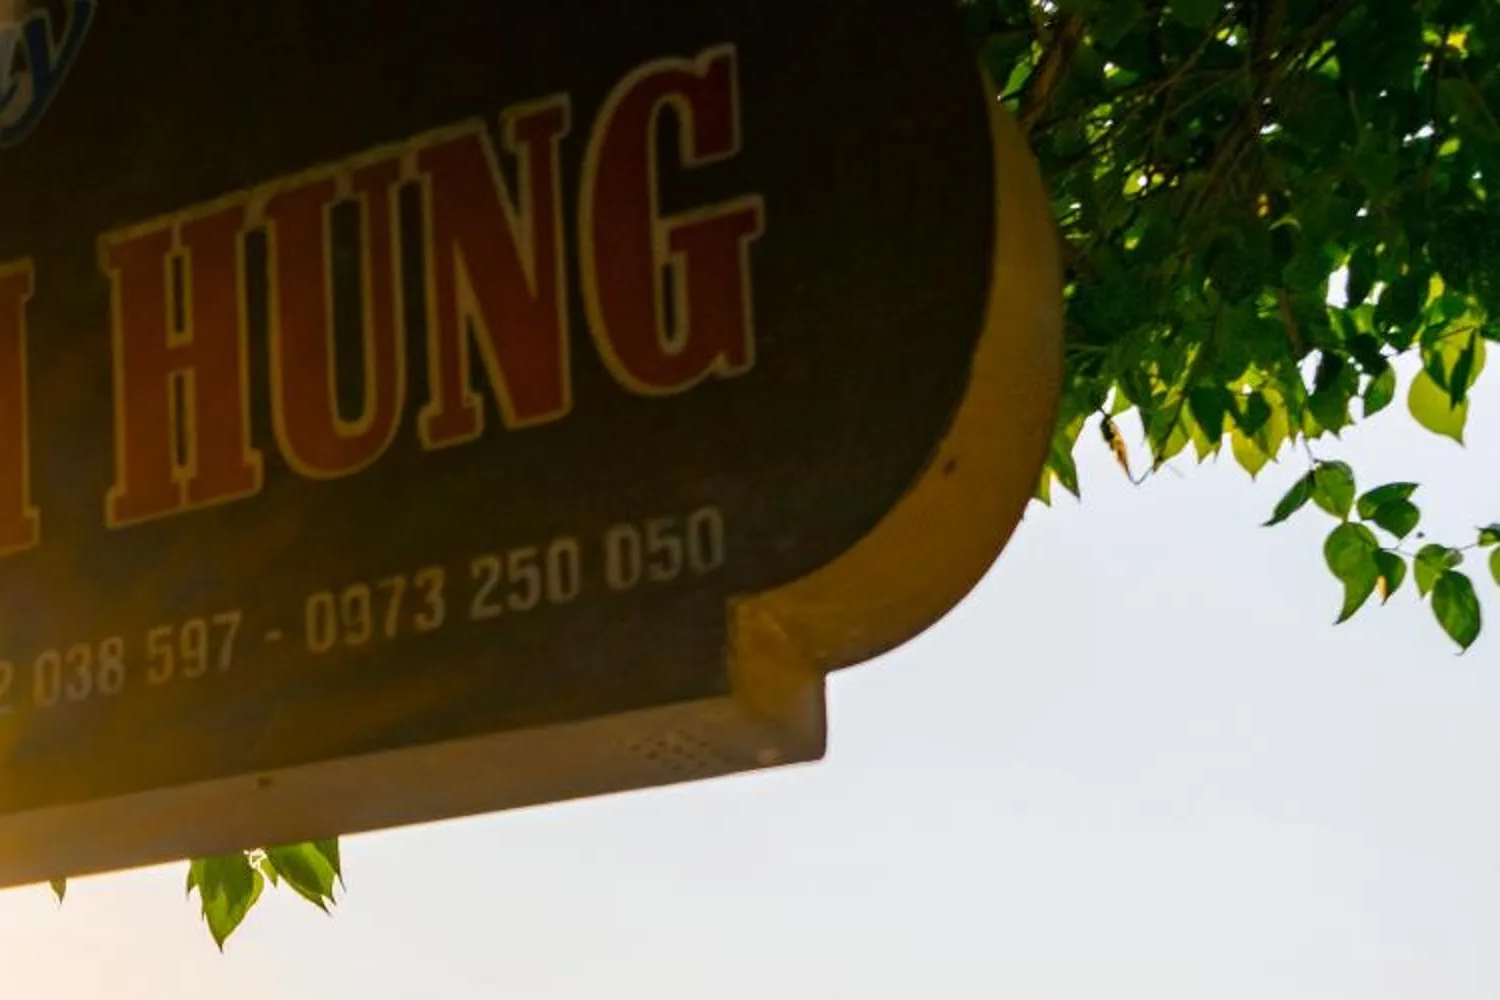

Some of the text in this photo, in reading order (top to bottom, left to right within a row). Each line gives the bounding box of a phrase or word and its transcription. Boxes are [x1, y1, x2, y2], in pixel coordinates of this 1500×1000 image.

[96, 42, 765, 529] HUNG
[32, 636, 127, 707] 038
[145, 608, 243, 686] 597
[304, 565, 446, 653] 0973
[469, 537, 582, 621] 250
[605, 505, 726, 590] 050
